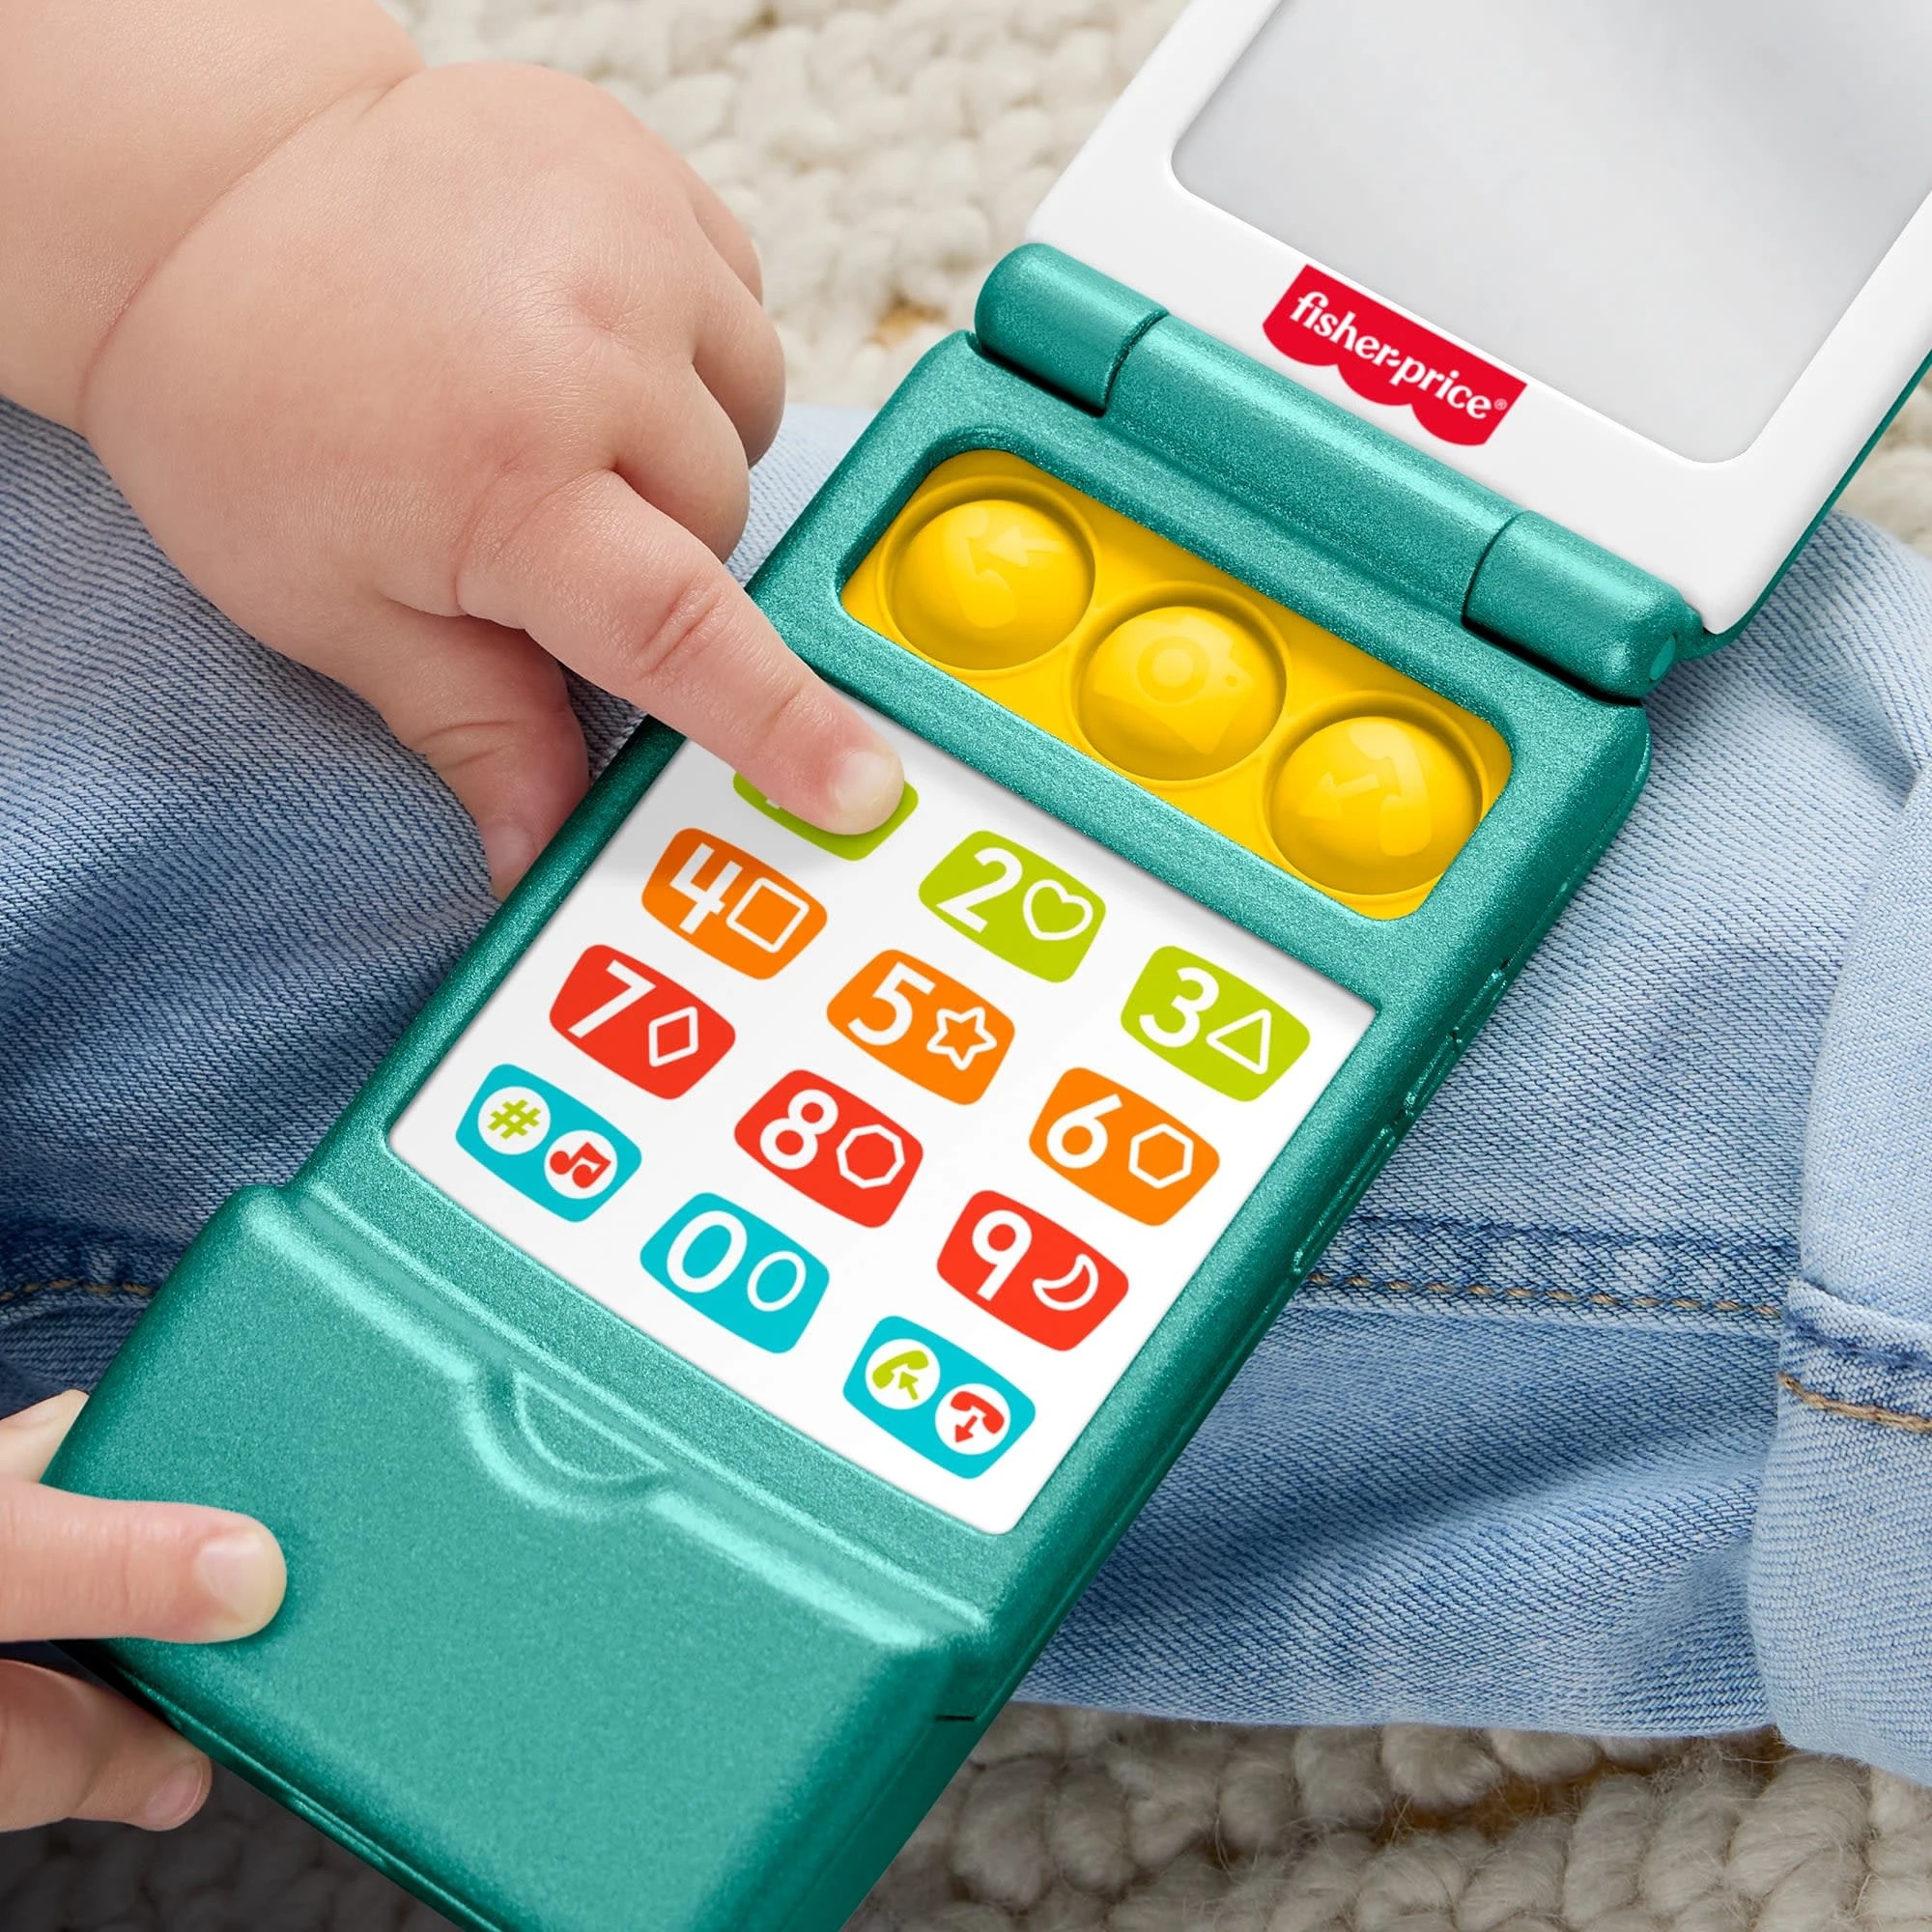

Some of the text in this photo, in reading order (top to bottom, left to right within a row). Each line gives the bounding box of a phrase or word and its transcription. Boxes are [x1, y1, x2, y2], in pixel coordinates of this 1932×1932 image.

[668, 842, 743, 935] 4
[937, 847, 1023, 933] 2
[567, 959, 656, 1039] 7
[847, 961, 936, 1046] 5
[1138, 966, 1219, 1049] 3
[487, 1098, 542, 1140] #
[759, 1088, 839, 1171] 8
[1045, 1094, 1122, 1170] 6
[666, 1209, 749, 1294] 0
[971, 1208, 1033, 1301] 9
